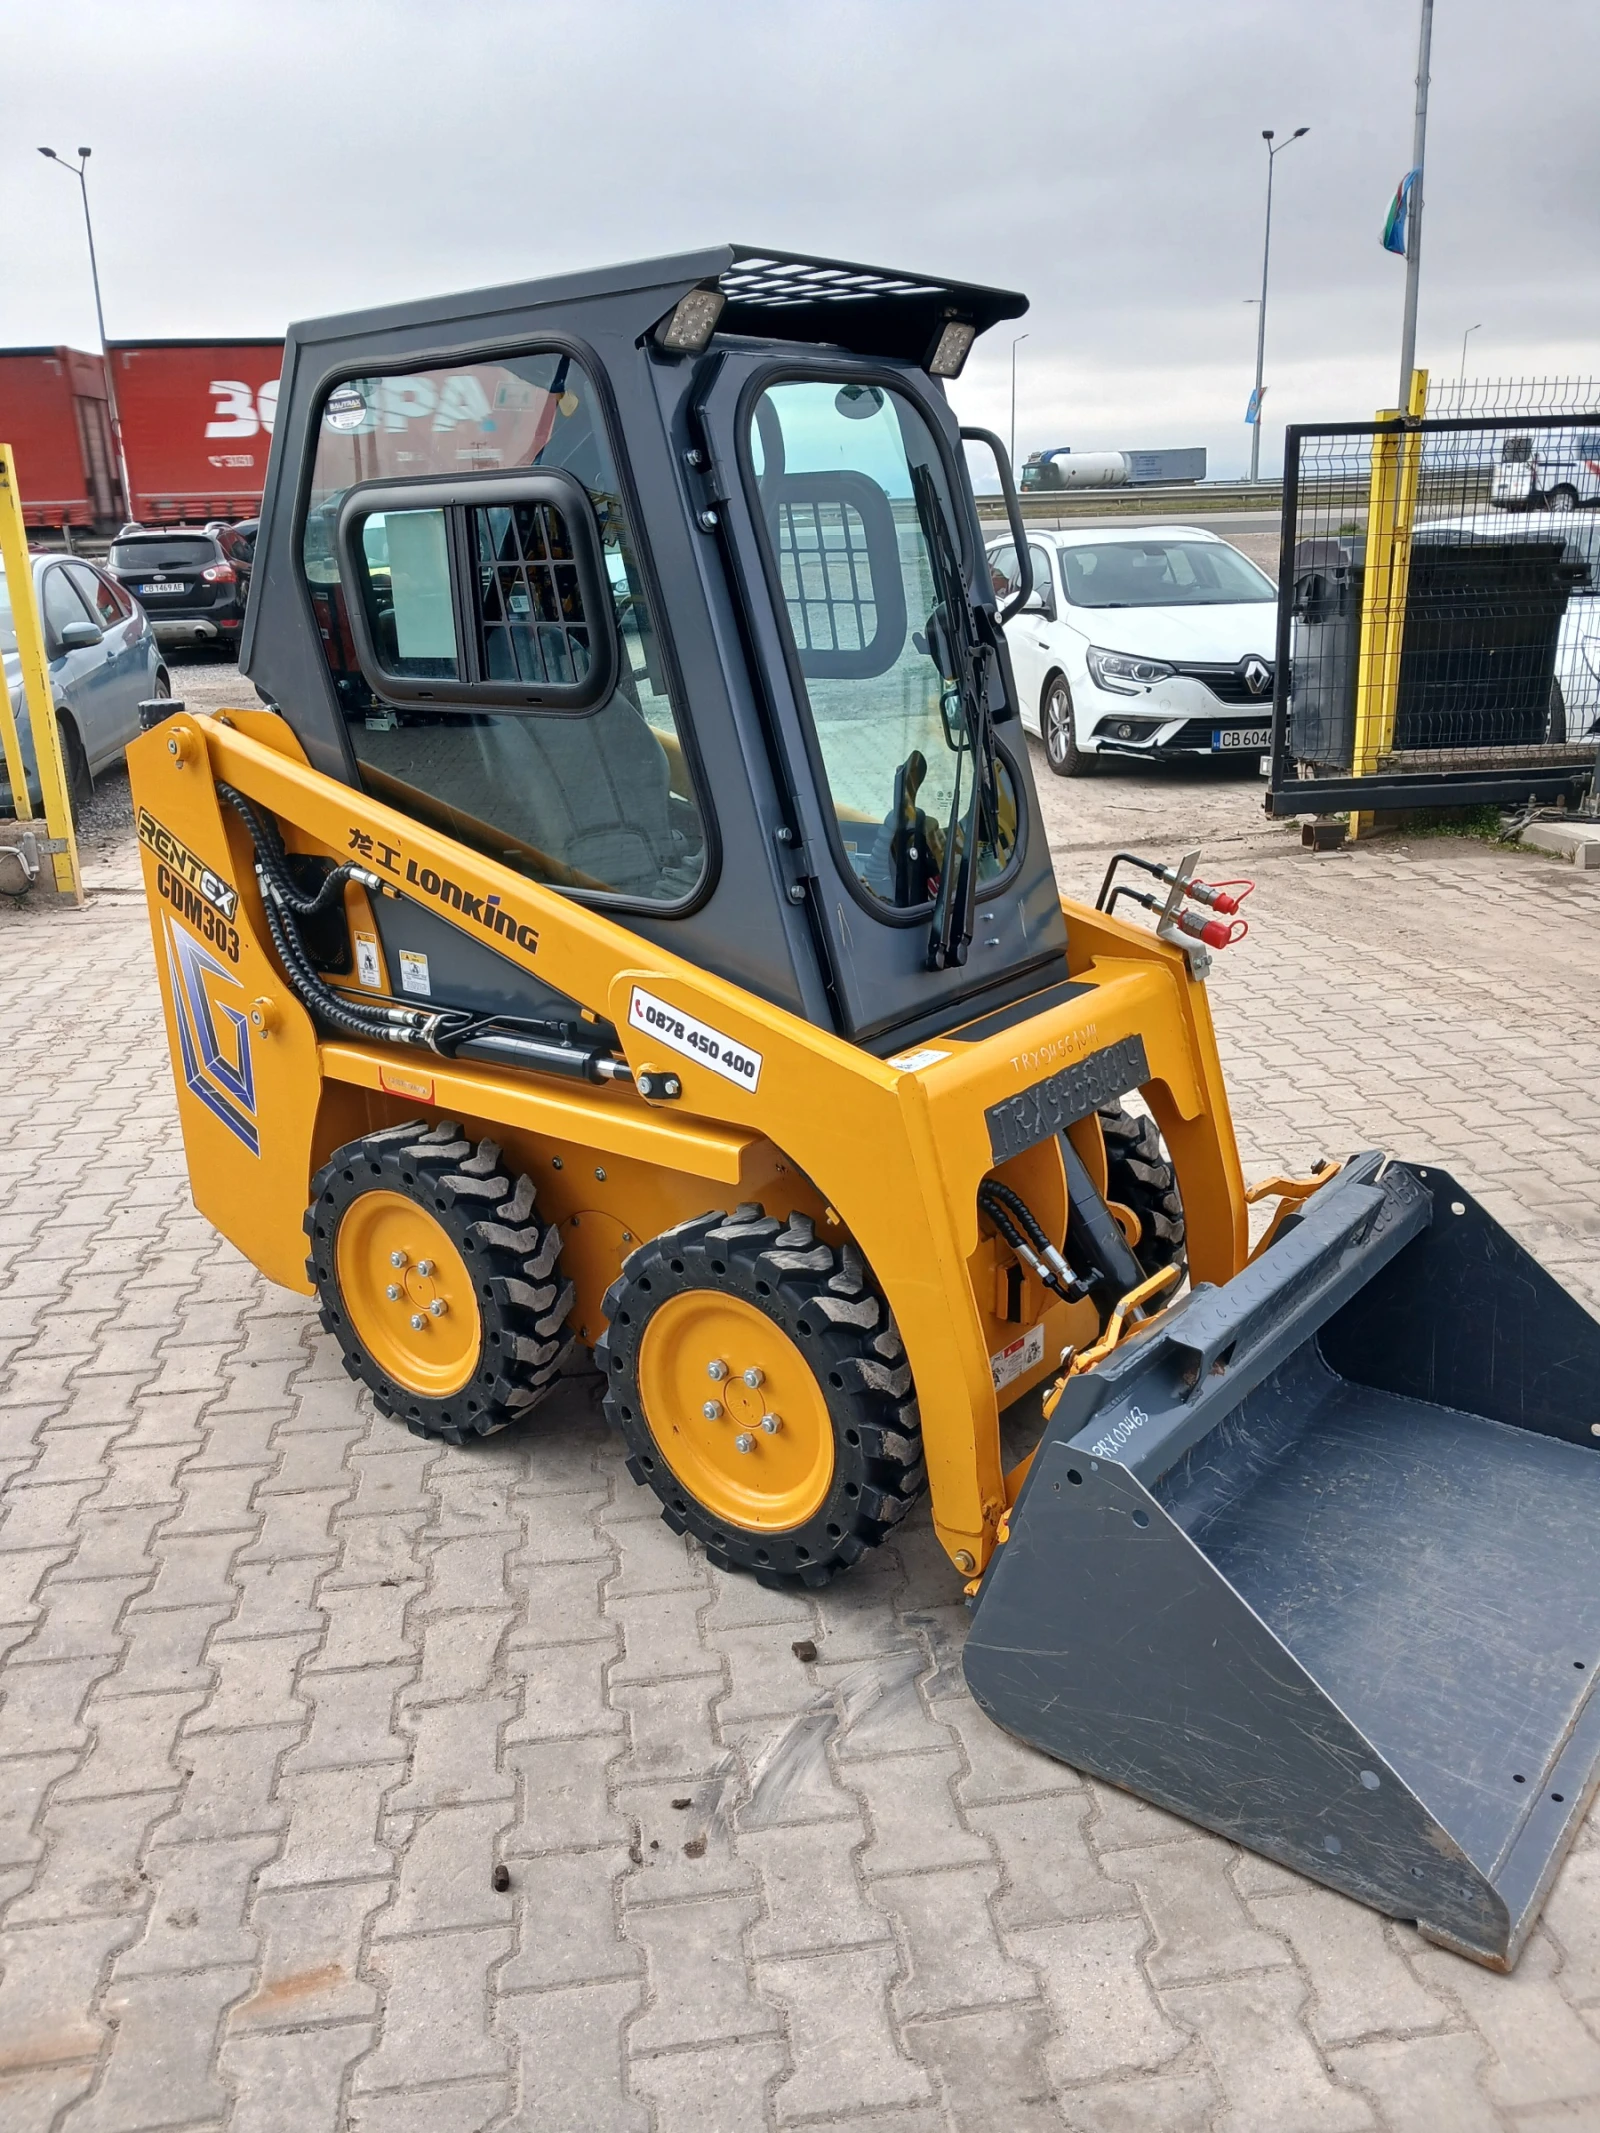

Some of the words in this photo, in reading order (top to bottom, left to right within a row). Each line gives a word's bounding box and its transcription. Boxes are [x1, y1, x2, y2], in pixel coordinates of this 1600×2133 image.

[156, 584, 172, 592] 1469
[173, 583, 182, 591] AE
[1222, 731, 1241, 747] CB
[139, 811, 236, 917] RENTEX
[348, 827, 401, 876] 龙工
[157, 863, 240, 964] CDM303
[645, 1005, 685, 1040] 0878
[687, 1031, 720, 1060] 450
[721, 1050, 756, 1078] 400
